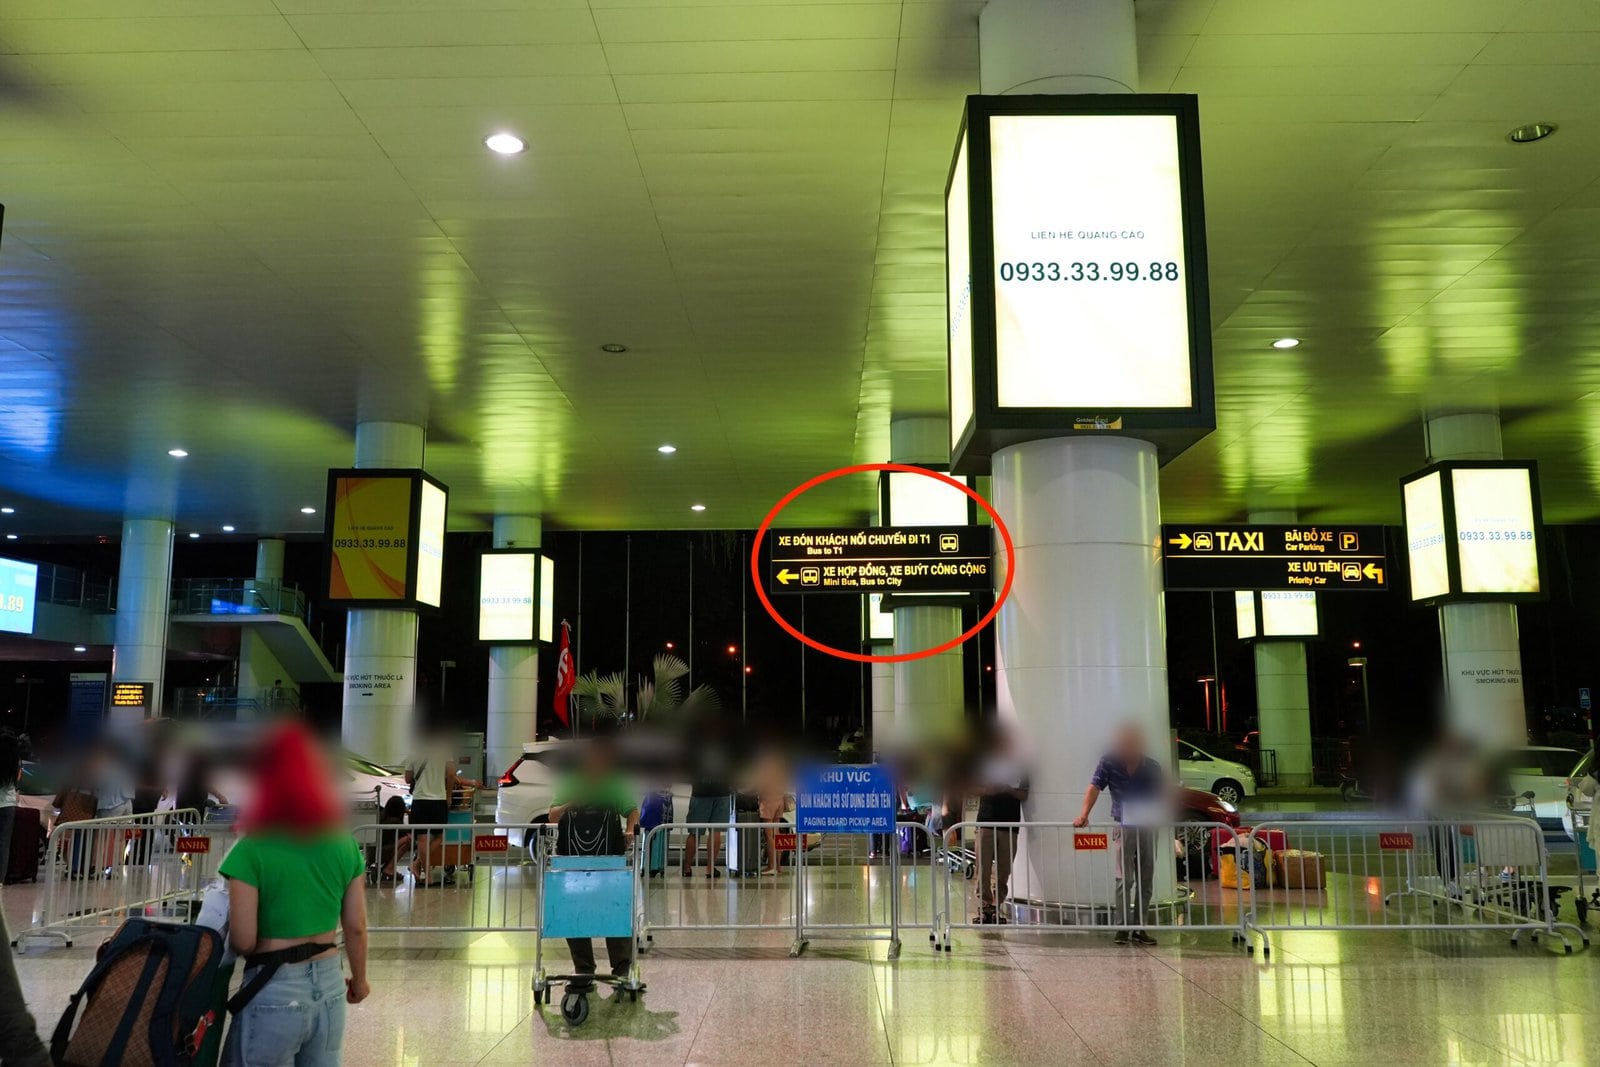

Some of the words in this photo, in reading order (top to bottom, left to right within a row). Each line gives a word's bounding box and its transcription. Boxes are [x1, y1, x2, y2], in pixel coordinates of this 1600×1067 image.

[1000, 262, 1178, 281] 0933.33.99.88
[779, 536, 791, 546] XE
[793, 533, 813, 546] ĐÓN
[815, 532, 848, 546] KHÁCH
[850, 531, 866, 545] NỐI
[868, 531, 906, 545] CHUYẾN
[908, 534, 918, 544] ĐI
[920, 534, 931, 544] T1
[1459, 531, 1533, 540] 0933.33.99.88
[335, 539, 406, 548] 0933.33.99.88
[1216, 532, 1264, 551] TAXI
[1320, 532, 1333, 541] XE
[807, 547, 822, 555] Bus
[1285, 543, 1298, 551] Car
[1299, 543, 1325, 552] Parking
[823, 567, 836, 576] XE
[838, 565, 857, 578] HỢP
[890, 566, 902, 575] XE
[904, 563, 928, 575] BUÝT
[931, 562, 957, 575] CÔNG
[960, 562, 986, 576] CỘNG
[1288, 562, 1301, 572] XE
[1319, 560, 1340, 572] TIÊN
[824, 578, 839, 586] Mini
[841, 578, 859, 586] Bus,
[860, 578, 876, 586] Bus
[877, 577, 885, 585] to
[887, 577, 902, 587] City
[1288, 576, 1313, 585] Priority
[847, 770, 871, 786] VỰC
[803, 817, 826, 826] PAGING
[827, 817, 848, 826] BOARD
[849, 817, 870, 826] PICKUP
[871, 817, 887, 826] AREA
[180, 841, 207, 849] ANHK
[1077, 838, 1106, 846] ANHK
